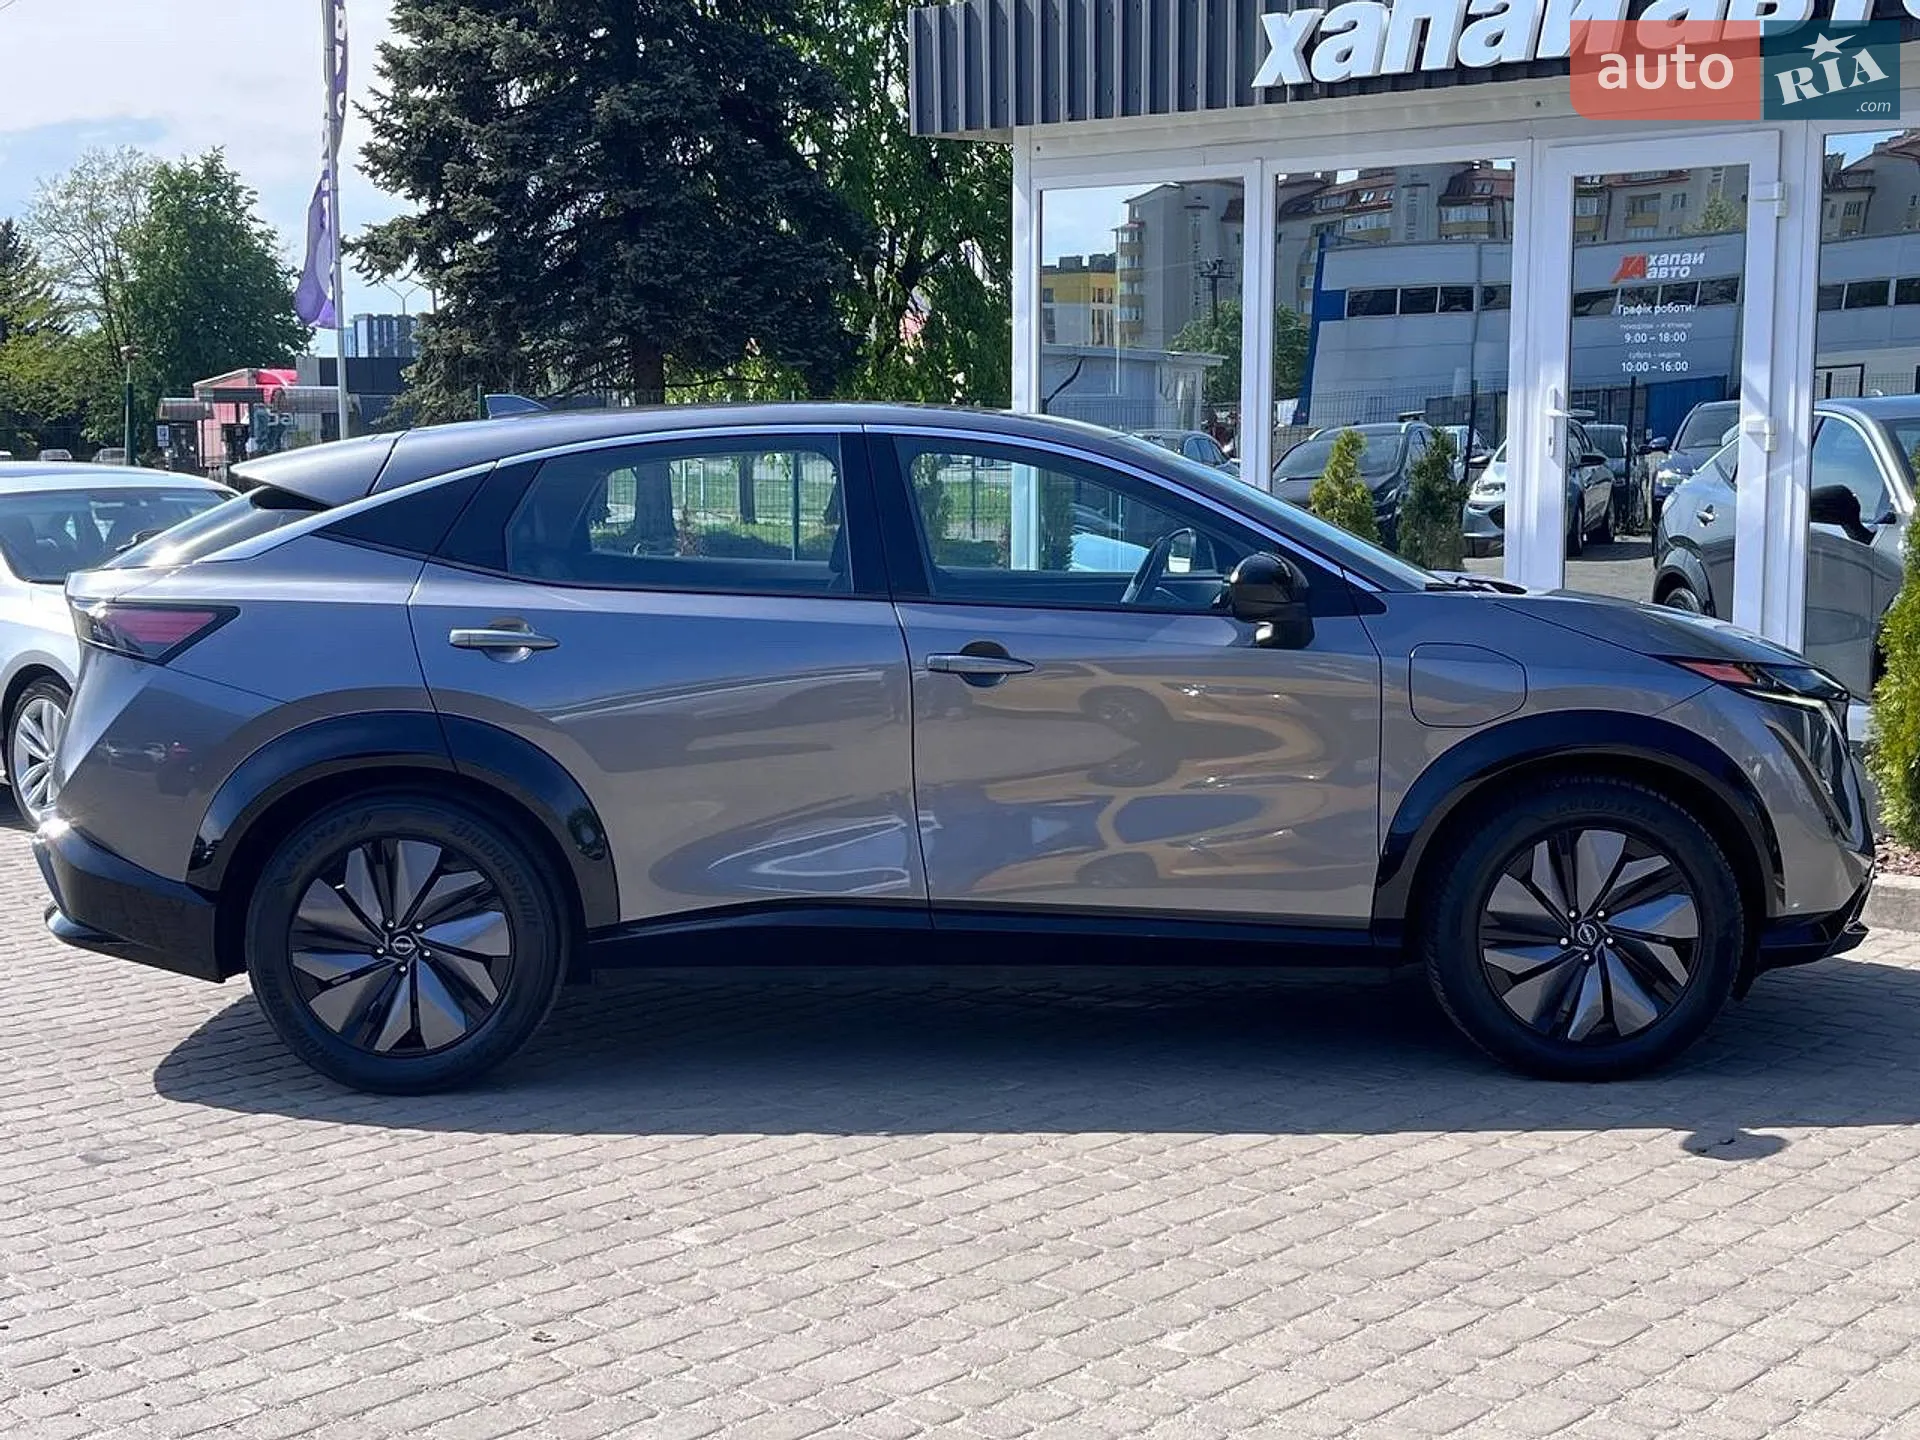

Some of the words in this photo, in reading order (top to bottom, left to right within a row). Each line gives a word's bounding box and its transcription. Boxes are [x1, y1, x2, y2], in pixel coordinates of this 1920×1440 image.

[1646, 265, 1691, 279] авто
[1618, 304, 1653, 316] Графік
[1624, 332, 1648, 344] 9:00
[1659, 331, 1687, 343] 18:00
[1621, 361, 1650, 372] 10:00
[1660, 360, 1689, 372] 16:00
